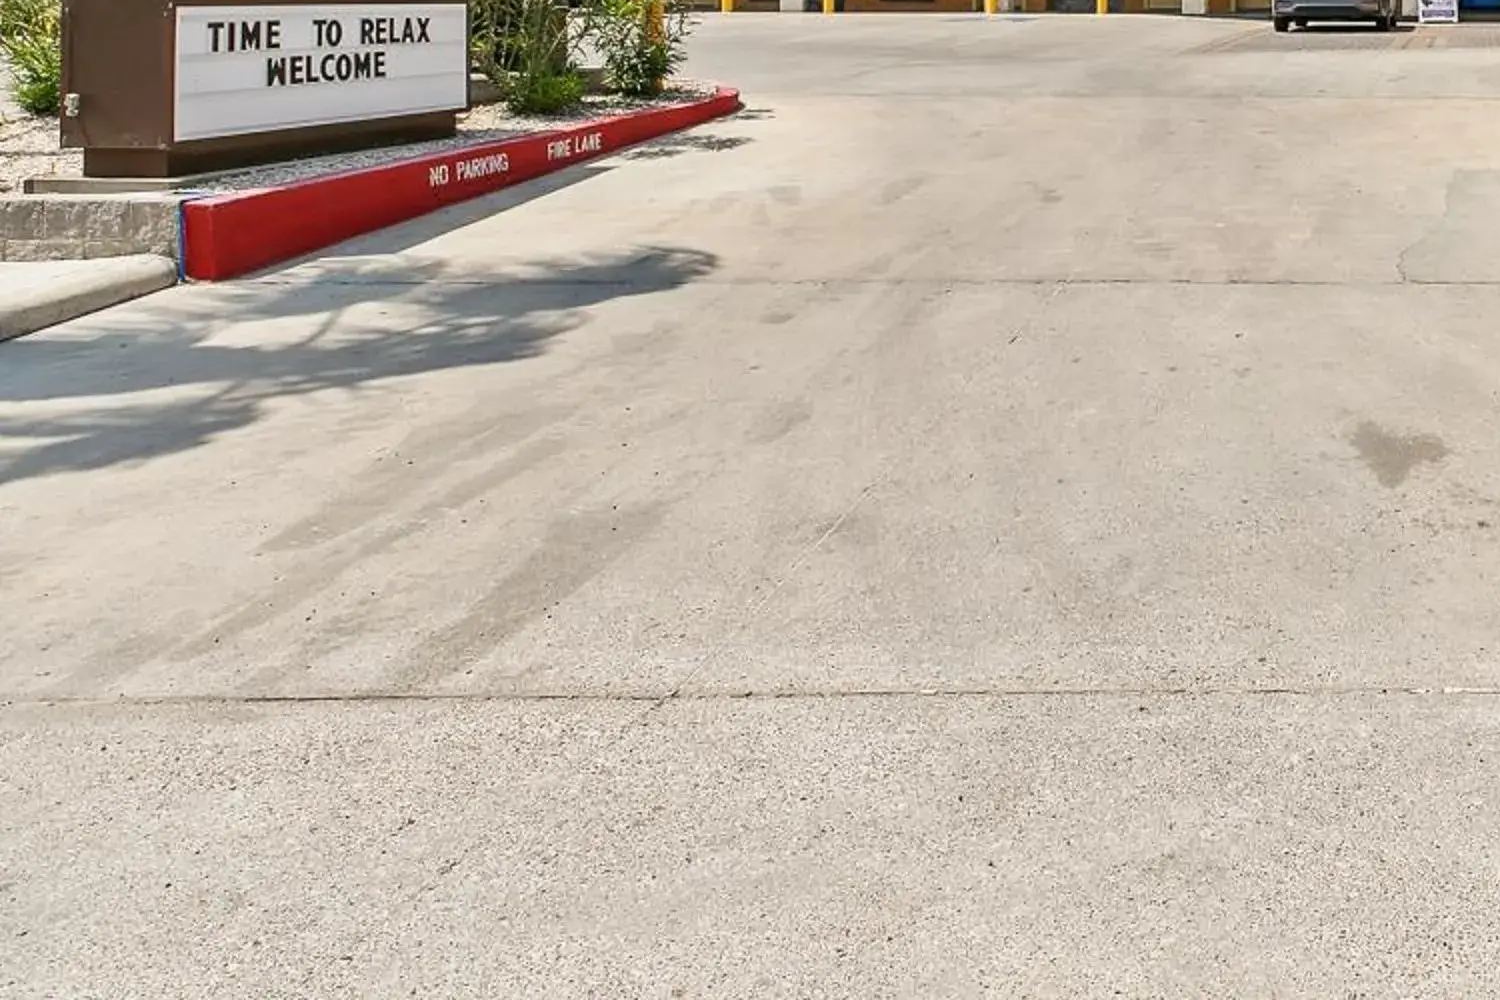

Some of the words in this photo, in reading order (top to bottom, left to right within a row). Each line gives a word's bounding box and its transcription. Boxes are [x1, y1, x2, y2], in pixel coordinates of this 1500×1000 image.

[207, 20, 281, 52] TIME
[312, 19, 342, 47] TO
[360, 17, 430, 45] RELAX
[266, 51, 386, 87] WELCOME
[429, 164, 449, 187] NO
[456, 153, 509, 181] PARKING
[547, 138, 571, 160] FIRE
[575, 132, 602, 153] LANE
